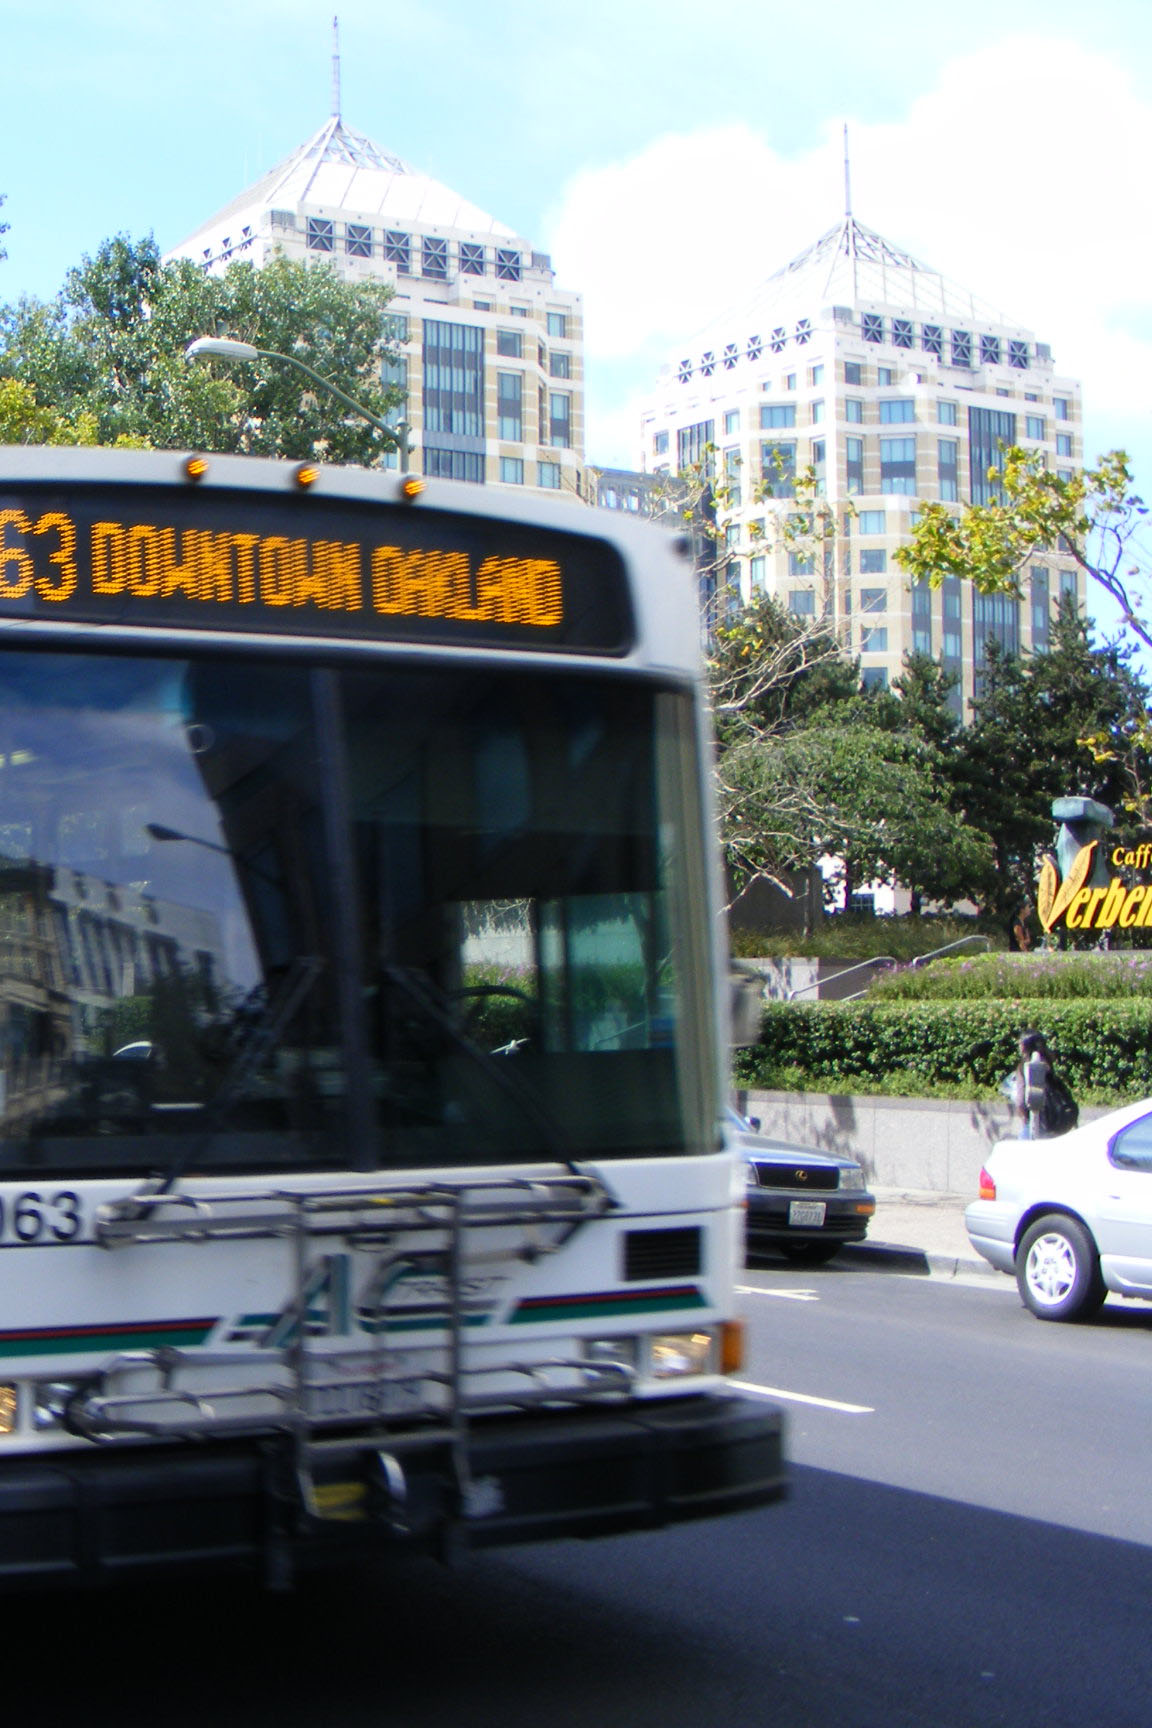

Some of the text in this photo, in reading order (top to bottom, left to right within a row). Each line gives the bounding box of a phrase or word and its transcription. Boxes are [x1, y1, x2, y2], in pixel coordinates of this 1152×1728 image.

[91, 521, 362, 612] DOWNTOWN
[371, 545, 564, 626] OAKLAND
[1112, 843, 1152, 869] Caff
